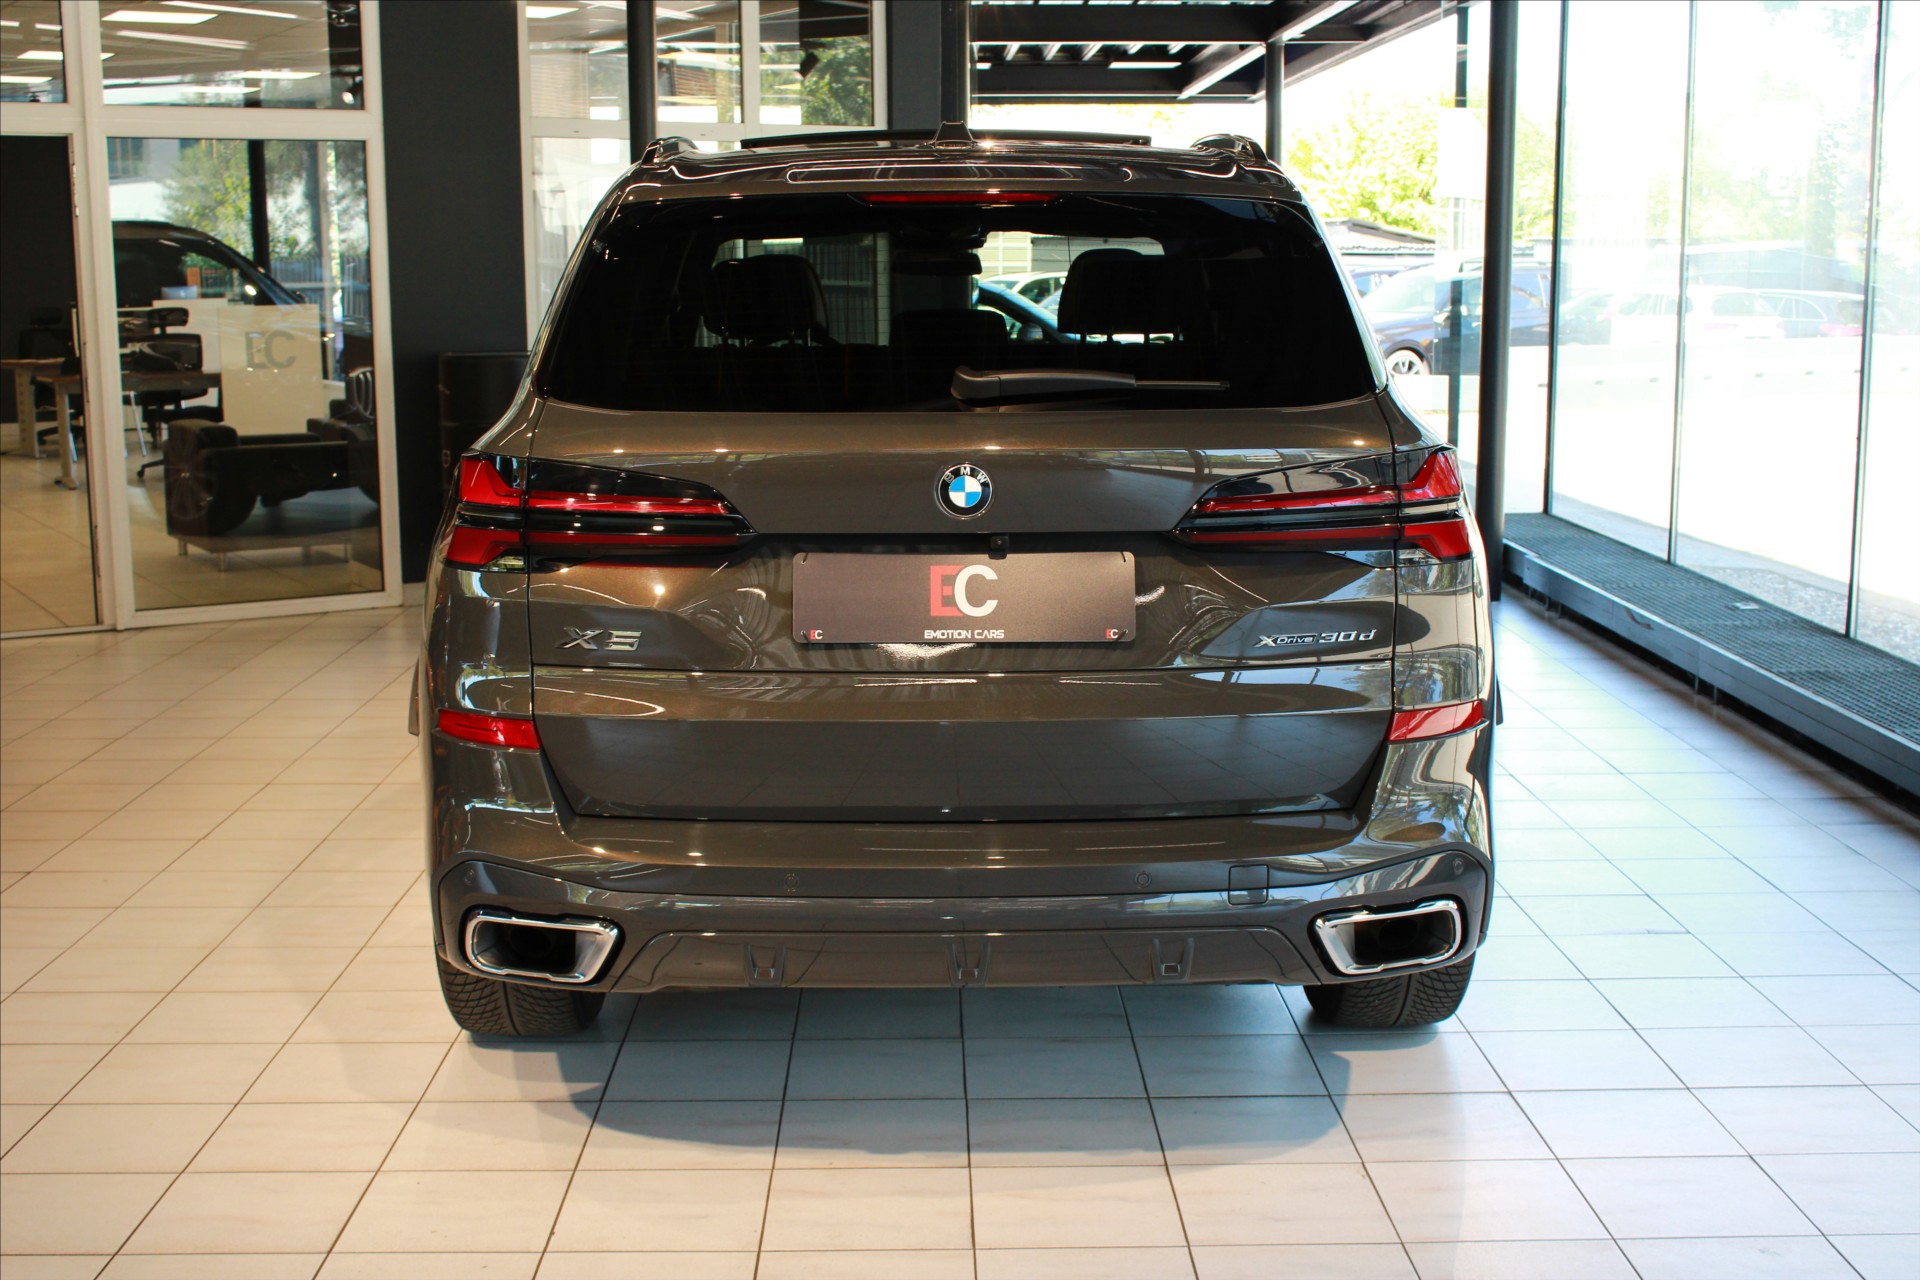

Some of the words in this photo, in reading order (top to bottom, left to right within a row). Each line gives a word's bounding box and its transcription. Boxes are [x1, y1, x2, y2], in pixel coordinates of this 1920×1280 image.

[943, 466, 989, 484] BMW
[930, 564, 998, 617] EC
[554, 627, 642, 651] X5
[810, 629, 823, 640] EC
[924, 629, 971, 639] EMOTION
[974, 629, 1005, 639] CARS
[1105, 628, 1119, 639] EC
